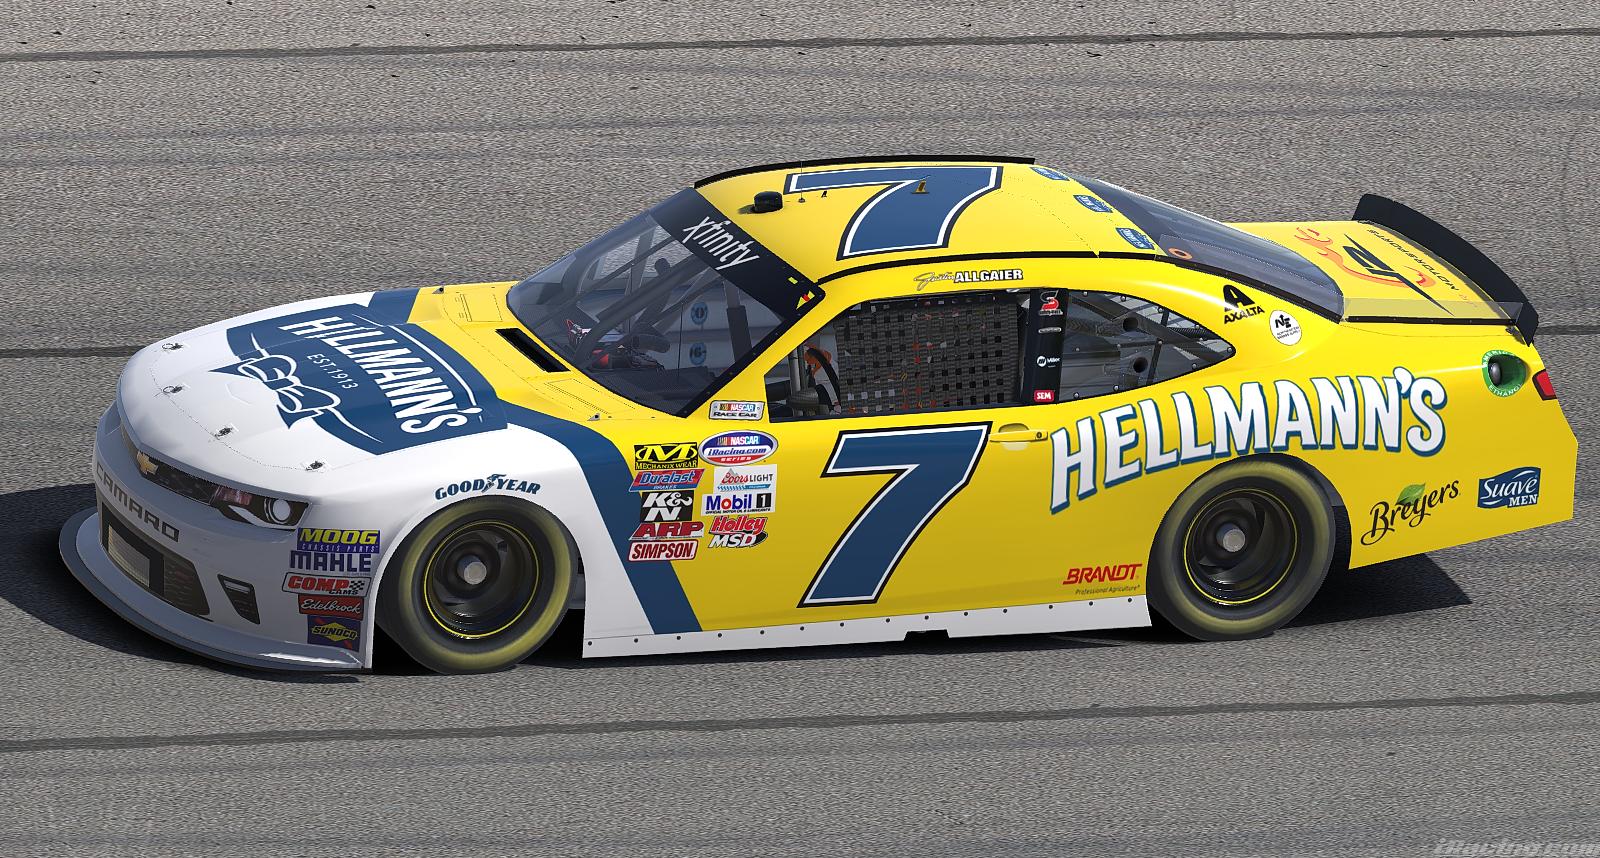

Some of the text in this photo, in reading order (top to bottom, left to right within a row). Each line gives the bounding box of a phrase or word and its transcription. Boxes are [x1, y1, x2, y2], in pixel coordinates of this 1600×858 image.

[783, 165, 1004, 261] 7
[682, 216, 760, 271] xfinity
[954, 268, 1024, 283] ALLGAIER
[1224, 305, 1266, 324] AXALTA
[307, 353, 358, 389] EST.1913
[1036, 392, 1052, 400] SEM
[730, 403, 756, 412] NASCAR
[730, 435, 759, 445] NASCAR
[1049, 366, 1447, 515] HELLMANN'S
[635, 460, 698, 470] MECHANIX WEAR
[640, 470, 697, 485] Duralast
[721, 472, 774, 484] Coors LIGHT
[1480, 476, 1538, 500] Suave
[97, 462, 180, 542] CAMARO
[706, 493, 752, 511] Mobil
[1508, 494, 1538, 507] MEN
[796, 421, 993, 608] 7
[1360, 480, 1459, 546] Breyers
[632, 522, 704, 537] ARP
[711, 515, 766, 535] Holley
[300, 529, 379, 545] MOOG
[708, 533, 757, 548] MSD
[302, 543, 376, 553] CHASSIS PARTS
[632, 542, 694, 560] SIMPSON
[290, 550, 372, 572] MAHLE
[1062, 563, 1143, 585] BRANDT
[287, 576, 350, 592] COMP
[301, 599, 361, 613] Edelbrock
[312, 626, 357, 639] SUNOCO
